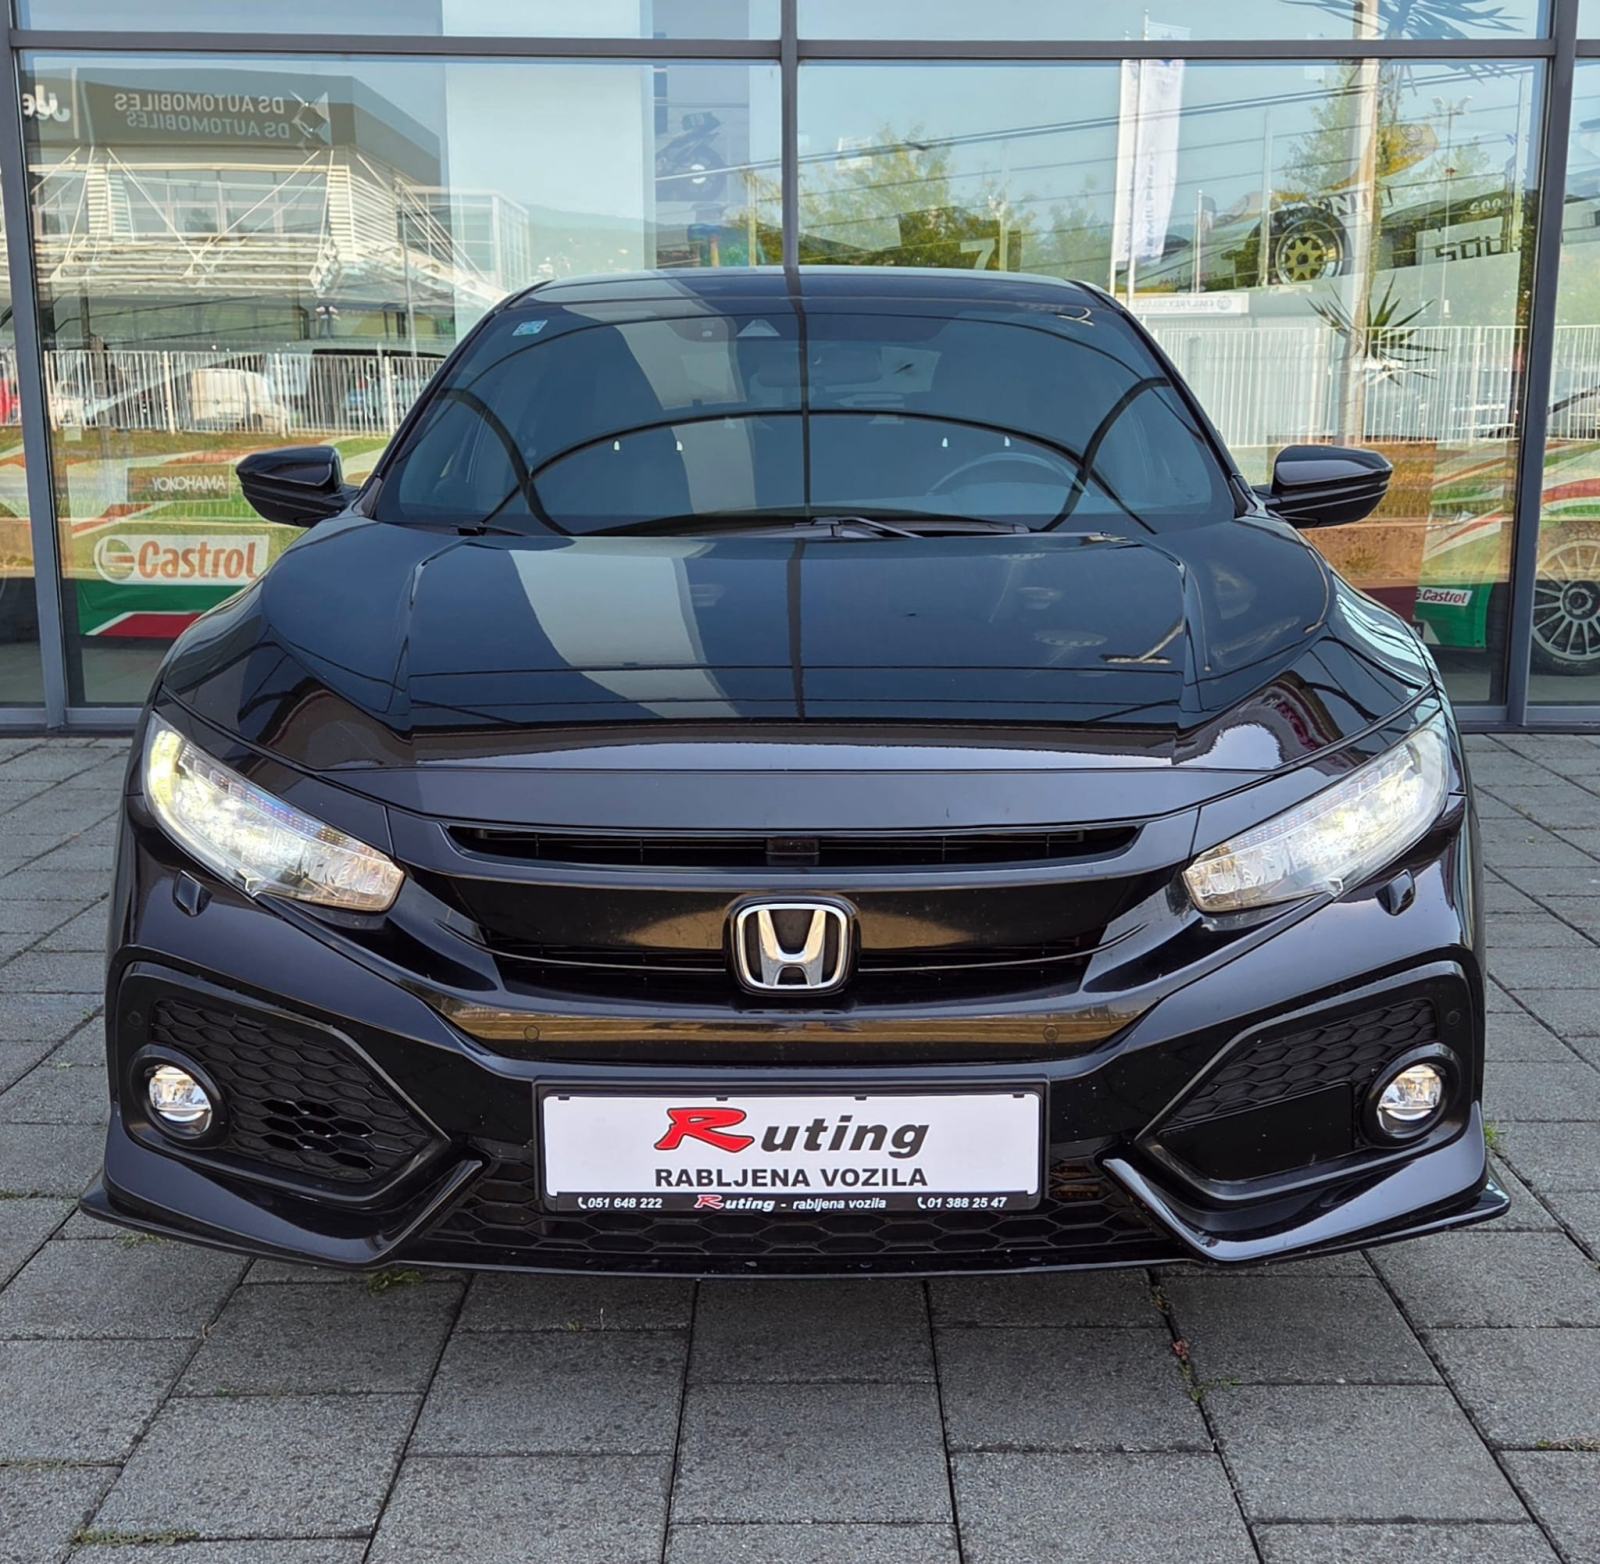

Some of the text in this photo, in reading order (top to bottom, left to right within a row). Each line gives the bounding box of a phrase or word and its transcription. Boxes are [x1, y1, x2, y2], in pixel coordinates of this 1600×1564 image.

[152, 474, 226, 493] YOKOHAMA
[138, 540, 257, 579] Castrol
[1422, 589, 1467, 604] Castrol
[653, 1107, 930, 1159] Ruting
[655, 1168, 928, 1187] RABLJENA VOZILA
[587, 1197, 662, 1209] 051 648 222
[694, 1194, 775, 1212] Ruting
[792, 1198, 845, 1212] rabljena
[848, 1197, 887, 1209] vozila
[927, 1196, 1007, 1209] 01 388 25 47
